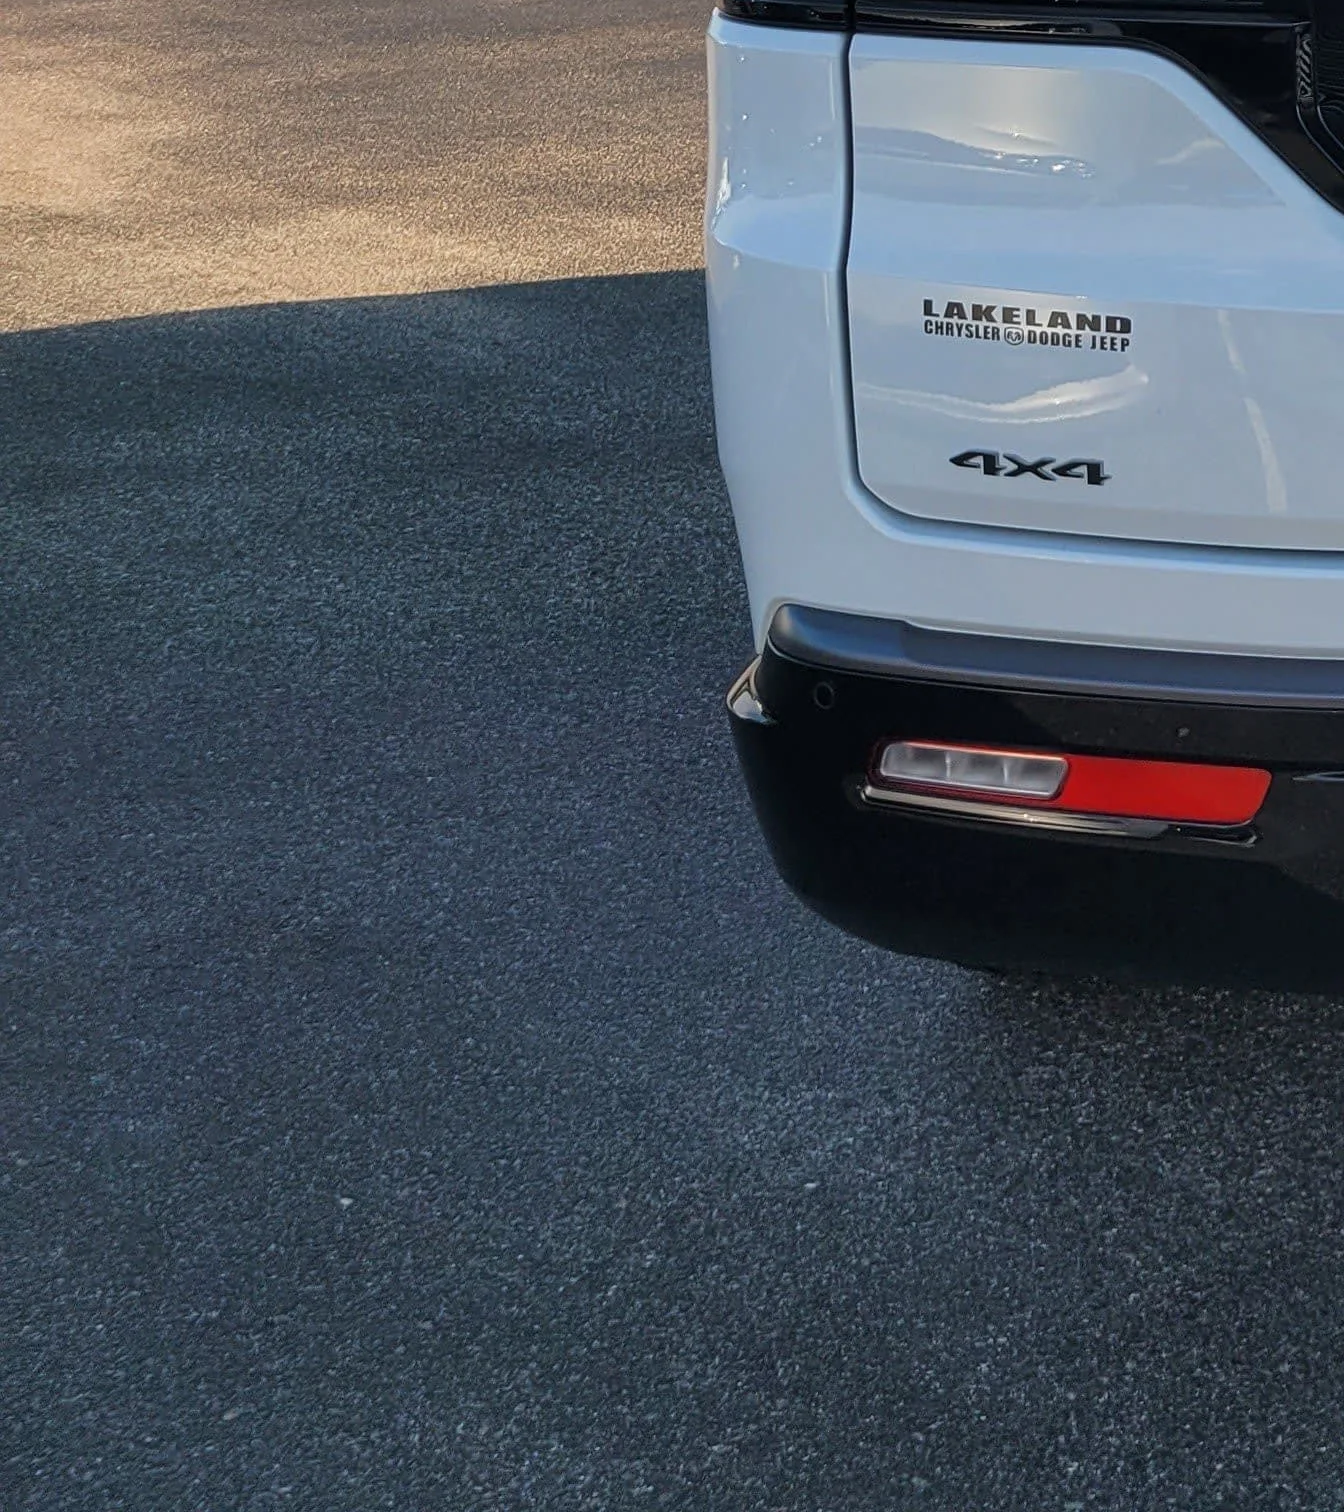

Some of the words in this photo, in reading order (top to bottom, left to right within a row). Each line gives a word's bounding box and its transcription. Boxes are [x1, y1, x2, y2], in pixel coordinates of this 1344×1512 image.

[922, 298, 1133, 335] LAKELAND
[923, 319, 1001, 341] CHRYSLER
[1027, 330, 1082, 349] DODGE
[1090, 335, 1130, 353] JEEP
